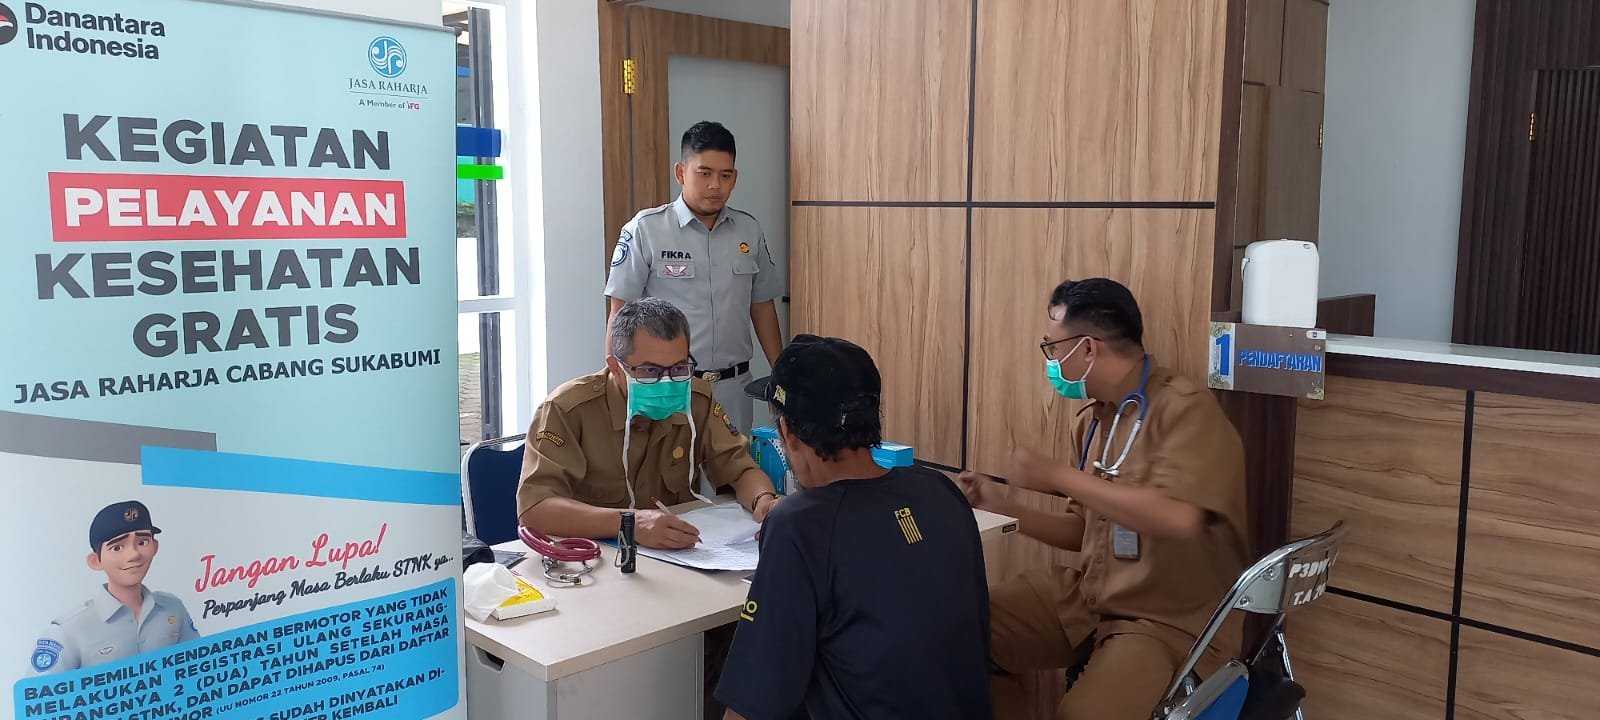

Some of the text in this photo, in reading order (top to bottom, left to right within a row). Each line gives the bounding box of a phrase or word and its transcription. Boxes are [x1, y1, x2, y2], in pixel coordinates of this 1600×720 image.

[25, 2, 165, 37] Danantara
[26, 28, 159, 60] Indonesia
[349, 78, 428, 95] JASA RAHARJA
[367, 100, 396, 108] Member
[63, 113, 390, 170] KEGIATAN
[64, 187, 397, 227] PELAYANAN
[35, 247, 420, 300] KESEHATAN
[661, 250, 692, 260] FIKRA
[132, 303, 359, 358] GRATIS
[1215, 333, 1322, 376] 1 PENDAFTARAN
[13, 349, 441, 404] JASA RAHARJA CABANG SUKABUMI
[894, 507, 912, 520] FCB
[195, 523, 388, 593] Jangan Lupa!
[202, 588, 287, 619] Perpanjang
[290, 580, 331, 599] Masa
[335, 565, 391, 589] Berlaku
[393, 553, 433, 578] STNK
[25, 587, 448, 701] BAGI PEMILIK KENDARAAN BERMOTOR YANG TIDAK
[25, 602, 448, 717] MELAKUKAN REGISTRASI ULANG SEKURANG-
[174, 684, 184, 697] 2
[197, 666, 248, 691] (DUA)
[260, 648, 319, 671] TAHUN
[330, 628, 401, 654] SETELAH
[411, 615, 449, 635] MASA
[187, 688, 222, 709] DAN
[228, 671, 281, 696] DAPAT
[286, 653, 355, 679] DIHAPUS
[360, 644, 394, 662] DARI
[399, 627, 449, 652] DAFTAR
[216, 704, 233, 715] (UU
[235, 693, 269, 708] NOMOR
[271, 690, 282, 698] 22
[284, 681, 314, 693] TAHUN
[316, 675, 340, 687] 2009,
[343, 667, 370, 679] PASAL
[371, 664, 385, 672] 74)
[270, 667, 445, 720] SUDAH DINYATAKAN DI-
[332, 695, 398, 720] KEMBALI
